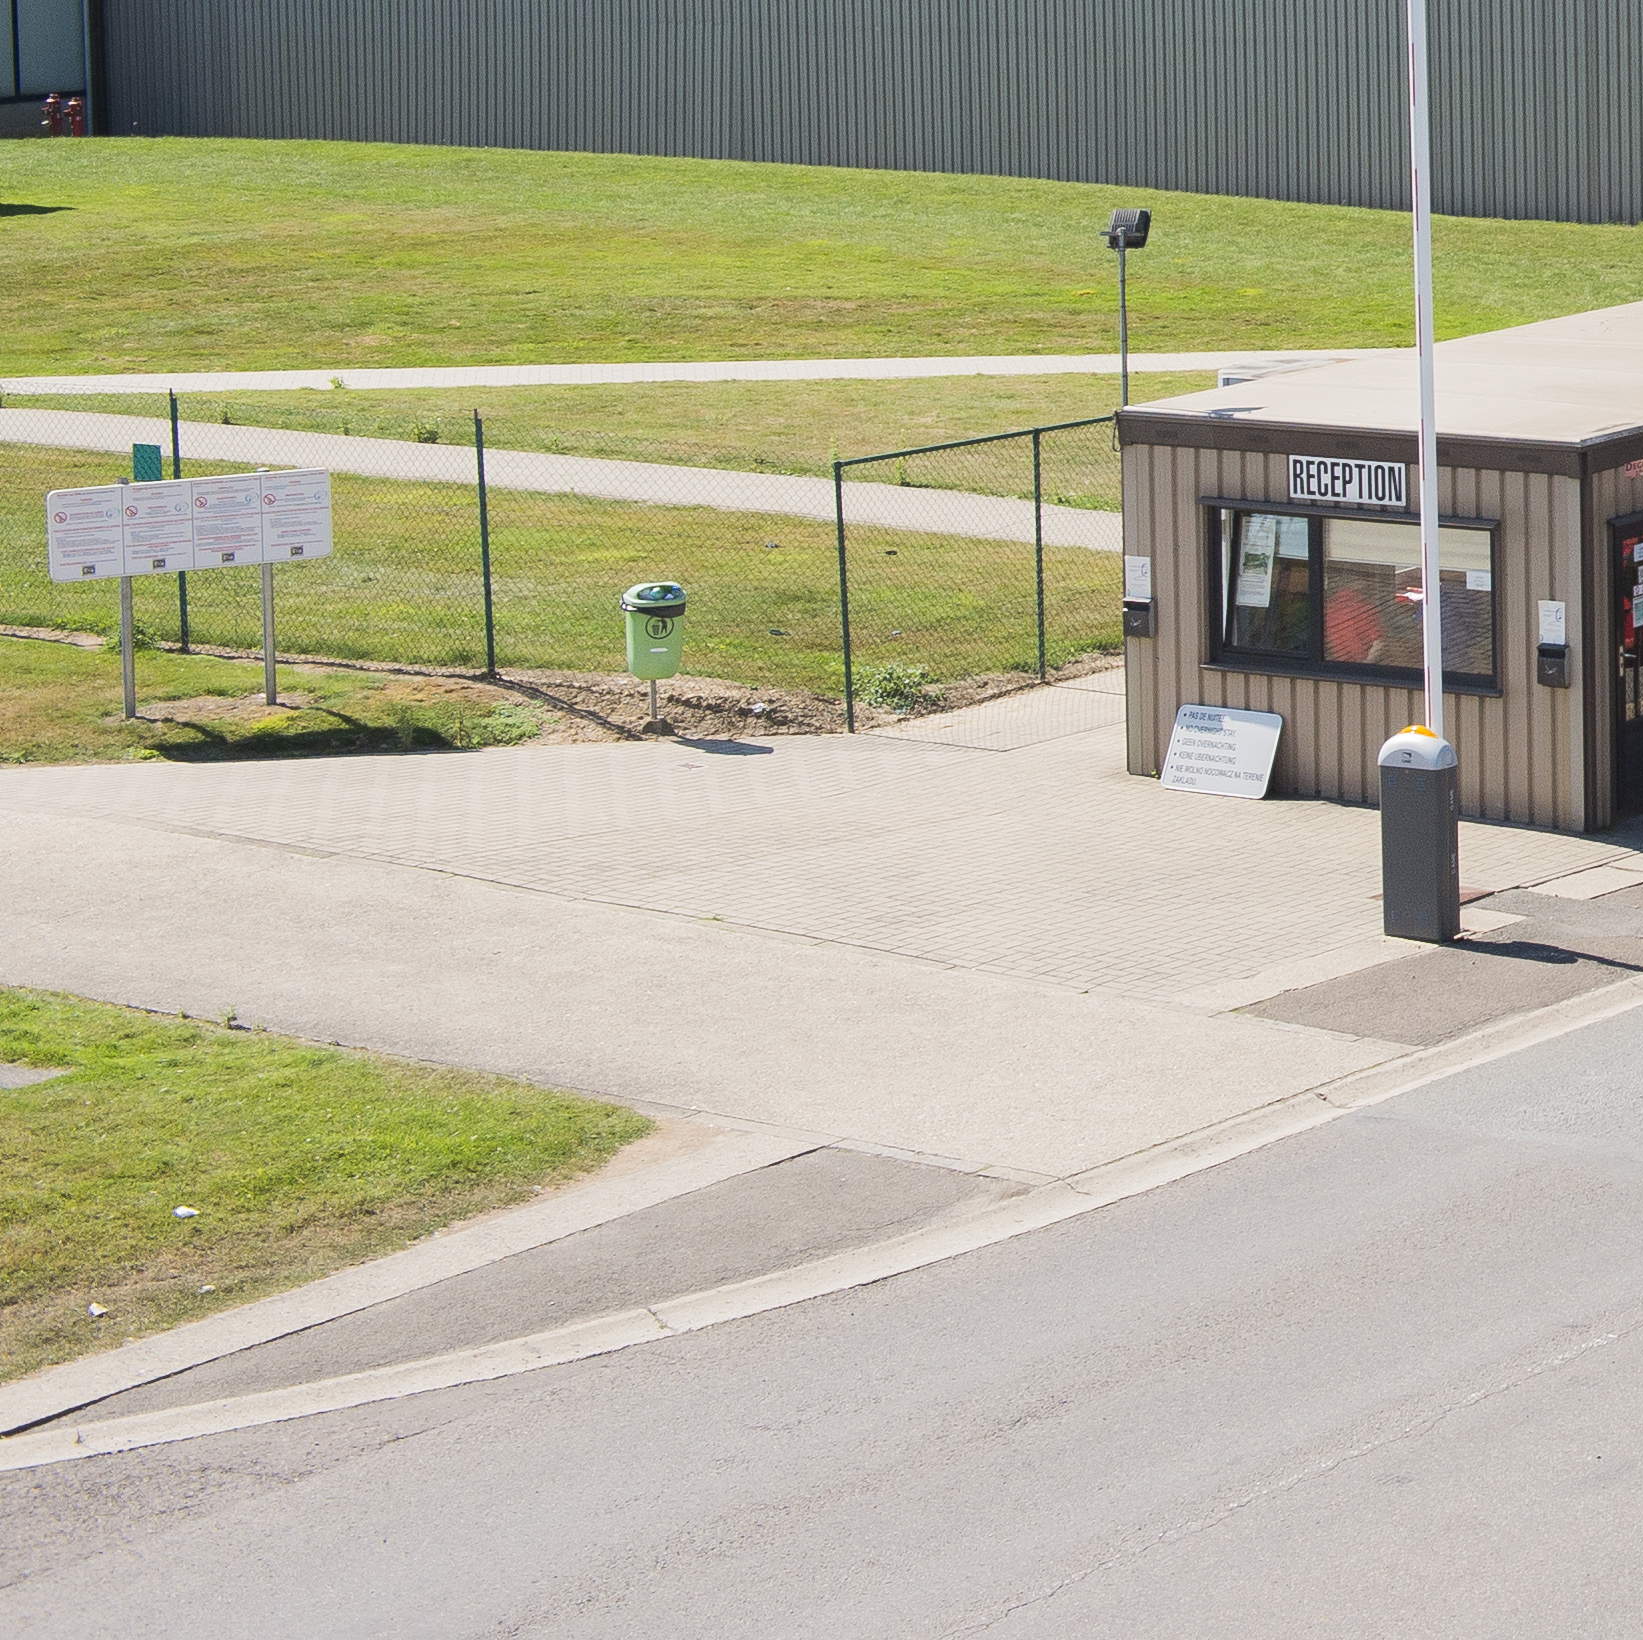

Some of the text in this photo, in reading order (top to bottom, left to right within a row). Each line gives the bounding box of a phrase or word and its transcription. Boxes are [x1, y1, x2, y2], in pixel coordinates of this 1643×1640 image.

[1292, 458, 1402, 502] RECEPTION
[1188, 711, 1199, 720] PAS
[1200, 712, 1208, 720] DE
[1185, 724, 1194, 732] NO
[1194, 725, 1223, 736] OVERNIGHT
[1182, 738, 1196, 746] GEEN
[1179, 751, 1194, 760] KEINE
